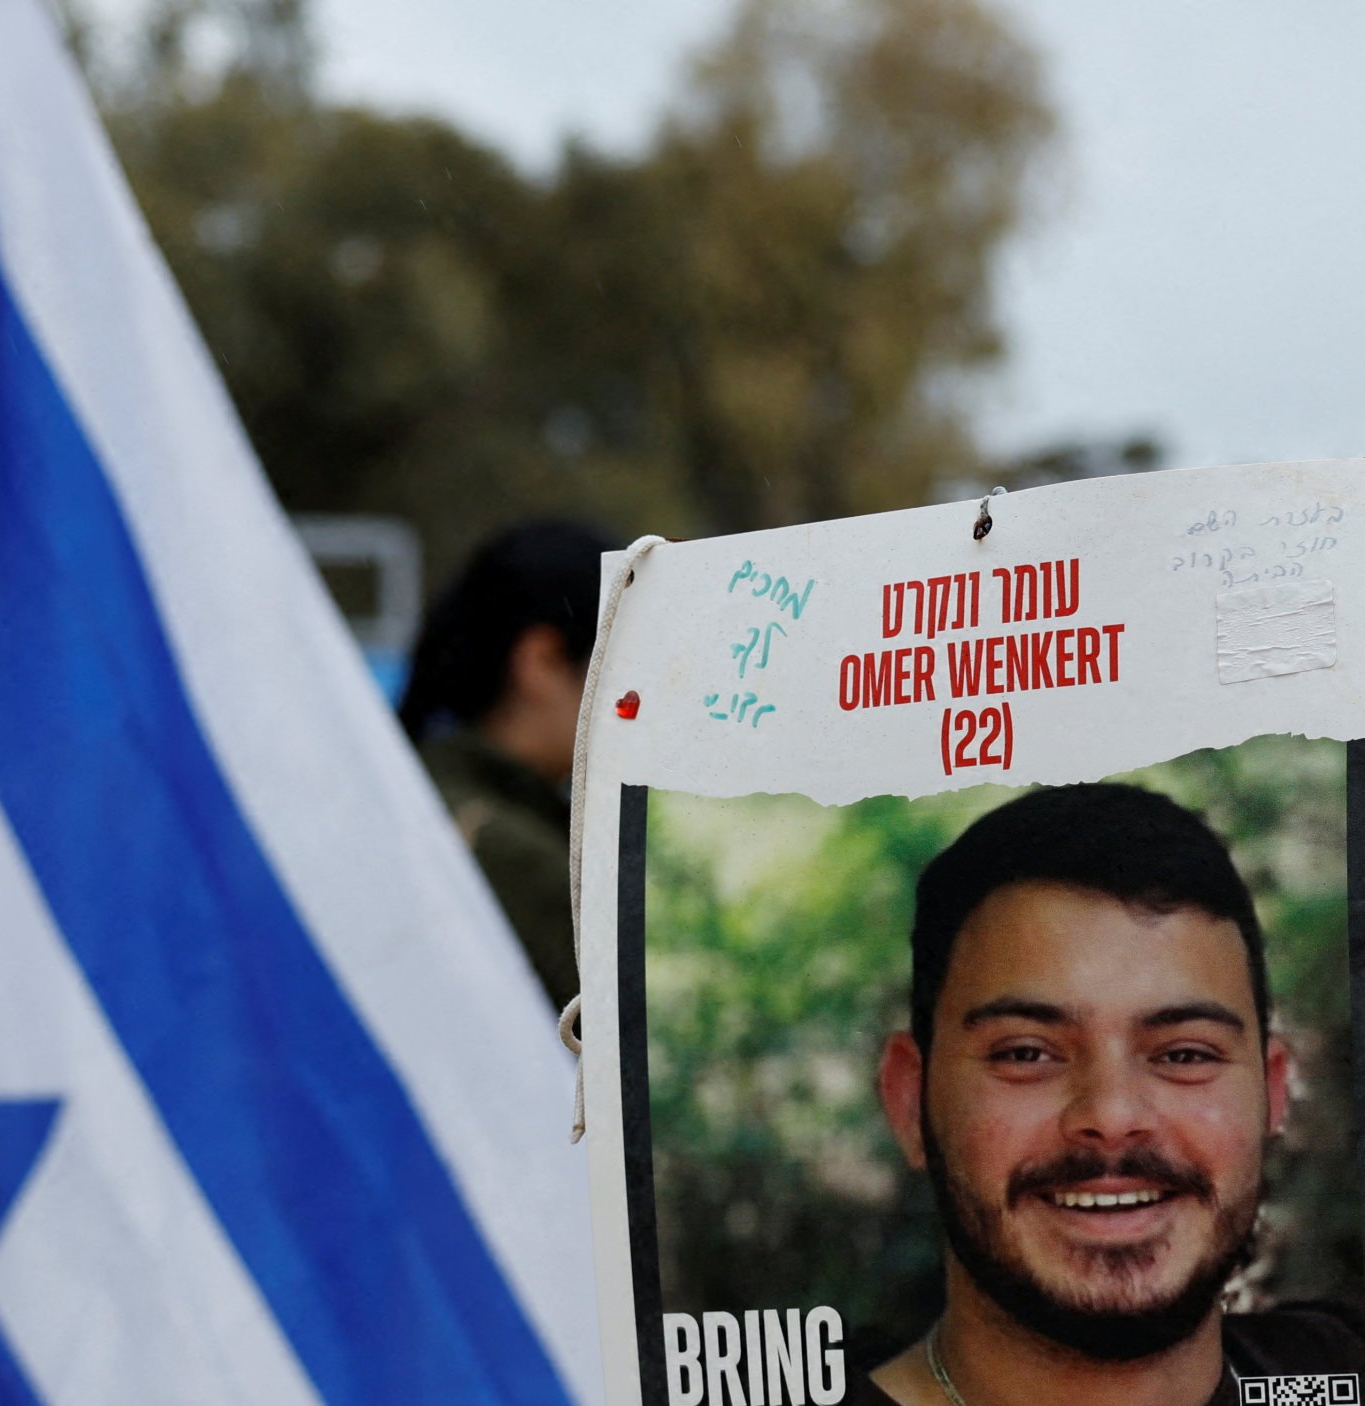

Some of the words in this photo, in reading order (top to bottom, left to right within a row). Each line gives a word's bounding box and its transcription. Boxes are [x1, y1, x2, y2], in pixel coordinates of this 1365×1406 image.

[728, 560, 815, 620] מחכים
[882, 571, 981, 640] ונקרט
[993, 560, 1080, 624] עומר
[839, 645, 936, 711] OMER
[947, 623, 1126, 699] WENKERT
[941, 702, 1014, 776] (22)
